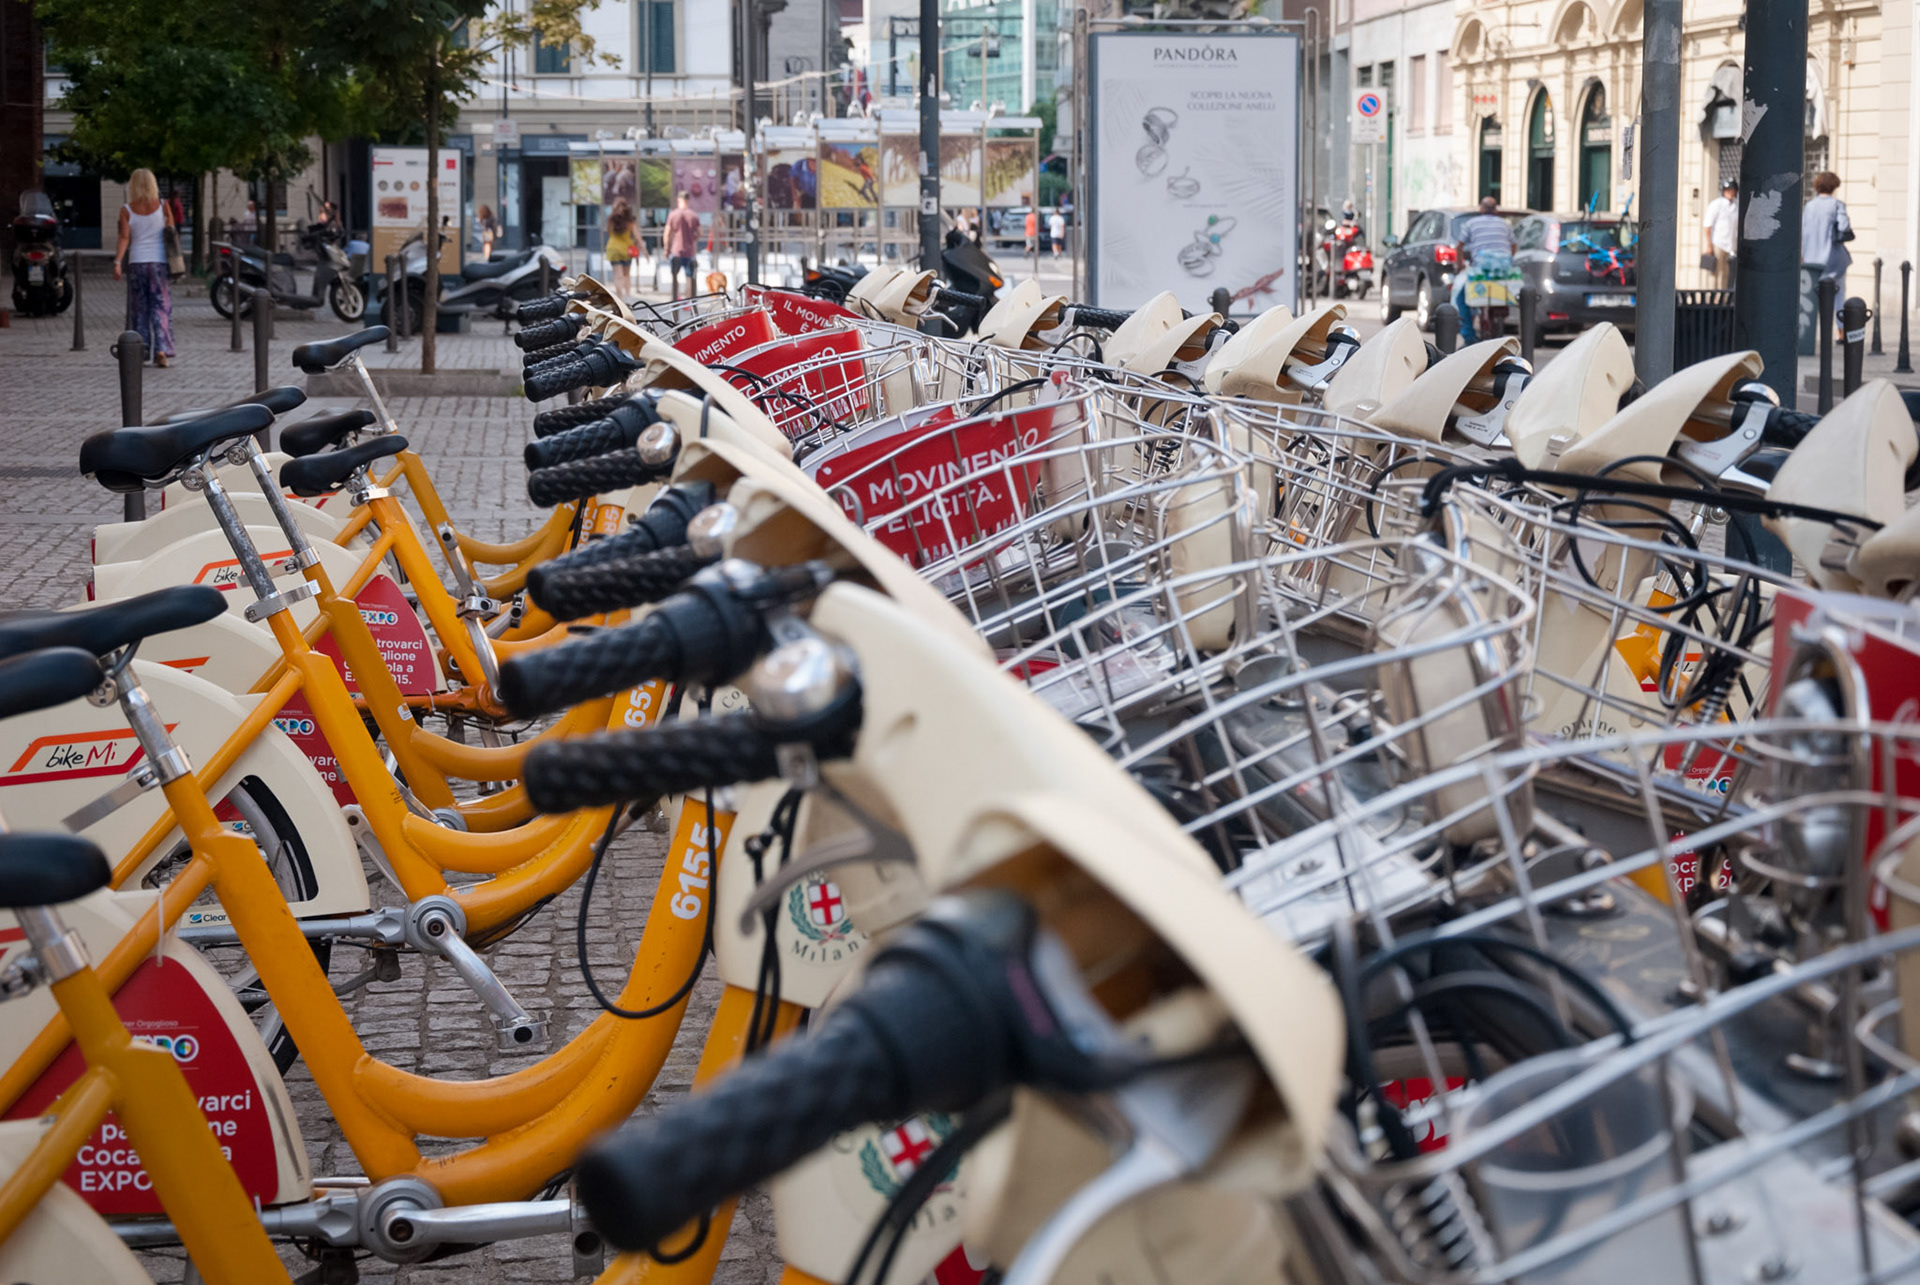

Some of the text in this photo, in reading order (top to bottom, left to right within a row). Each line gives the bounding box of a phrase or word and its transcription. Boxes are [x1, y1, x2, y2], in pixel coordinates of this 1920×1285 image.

[1238, 91, 1273, 100] NUOVA
[783, 300, 793, 312] IL
[692, 325, 746, 363] VIMENTO
[868, 427, 1039, 504] MOVIMENTO
[213, 567, 244, 583] bike
[376, 638, 423, 650] trovarci
[379, 650, 416, 661] glione
[272, 718, 315, 736] XPO
[670, 822, 722, 920] 6155
[791, 932, 867, 962] Milan
